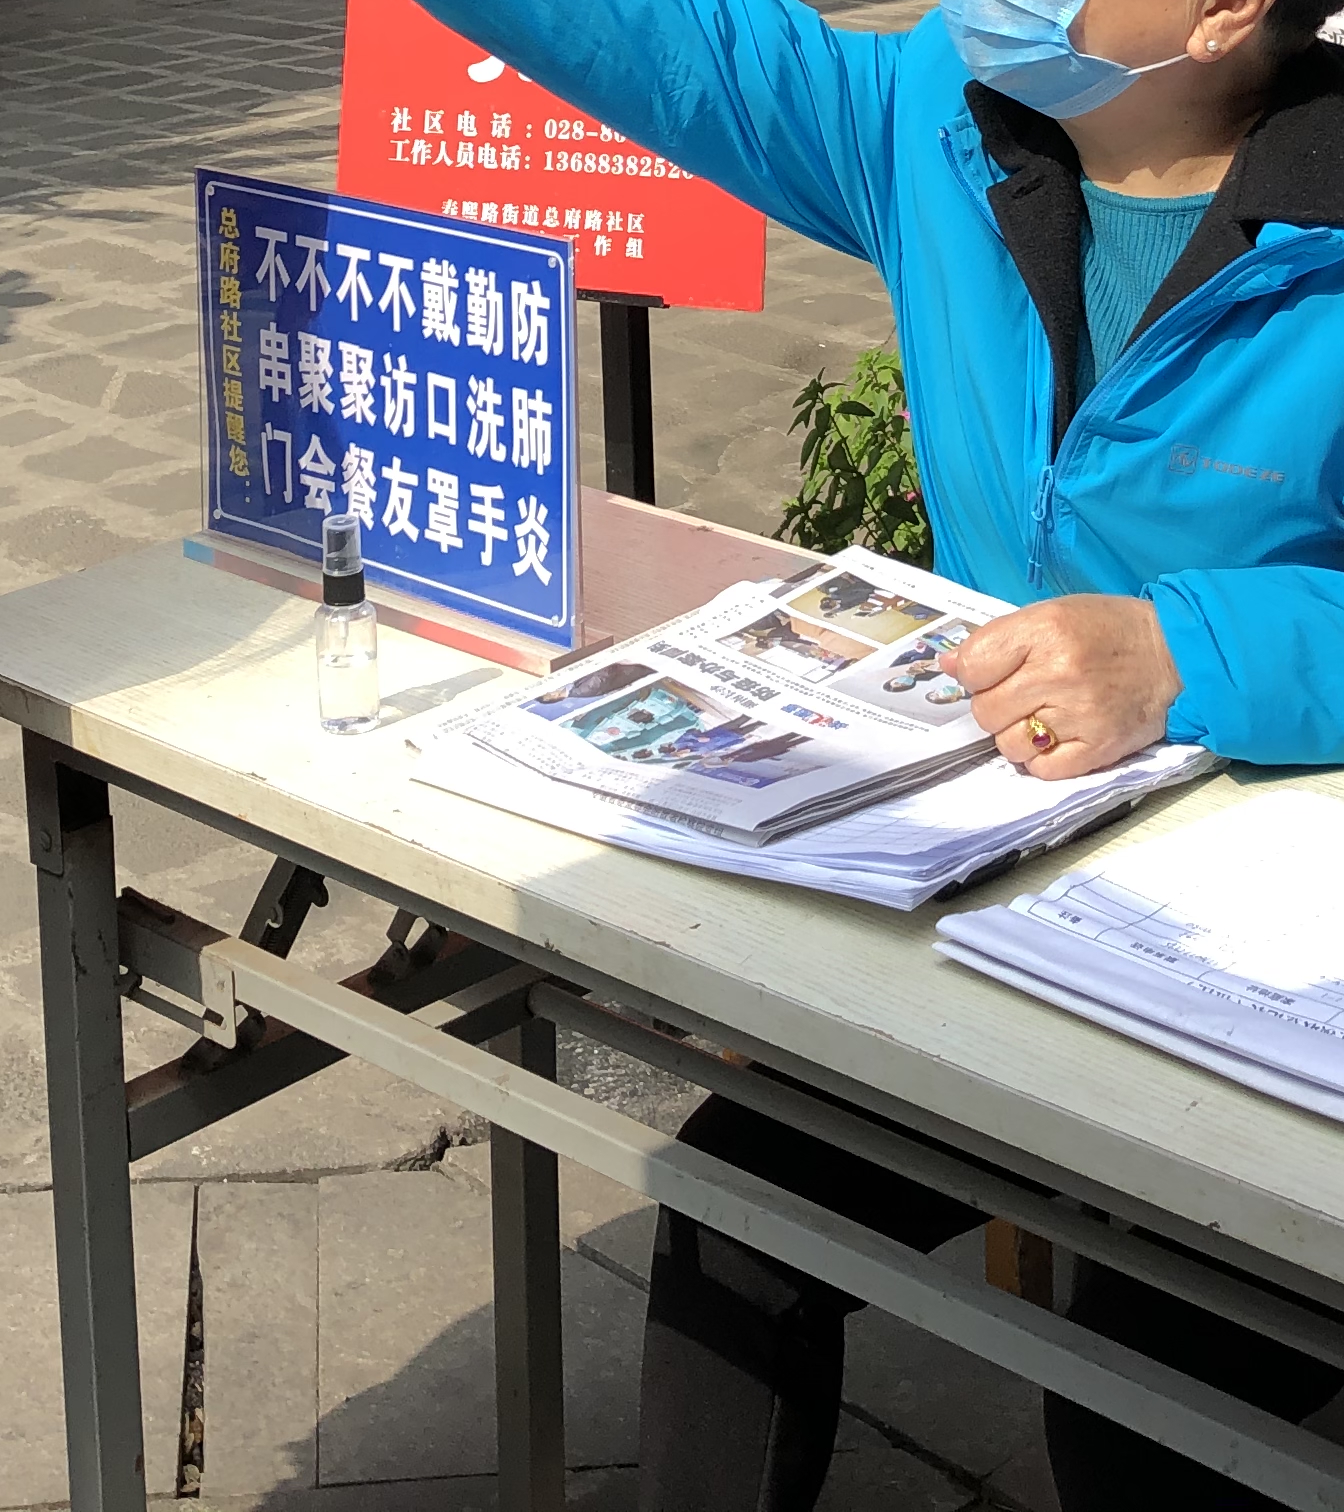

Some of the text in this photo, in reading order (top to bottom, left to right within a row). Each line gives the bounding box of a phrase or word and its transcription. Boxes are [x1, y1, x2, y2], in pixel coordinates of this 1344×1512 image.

[218, 206, 251, 505] 总府路社区提醒您：
